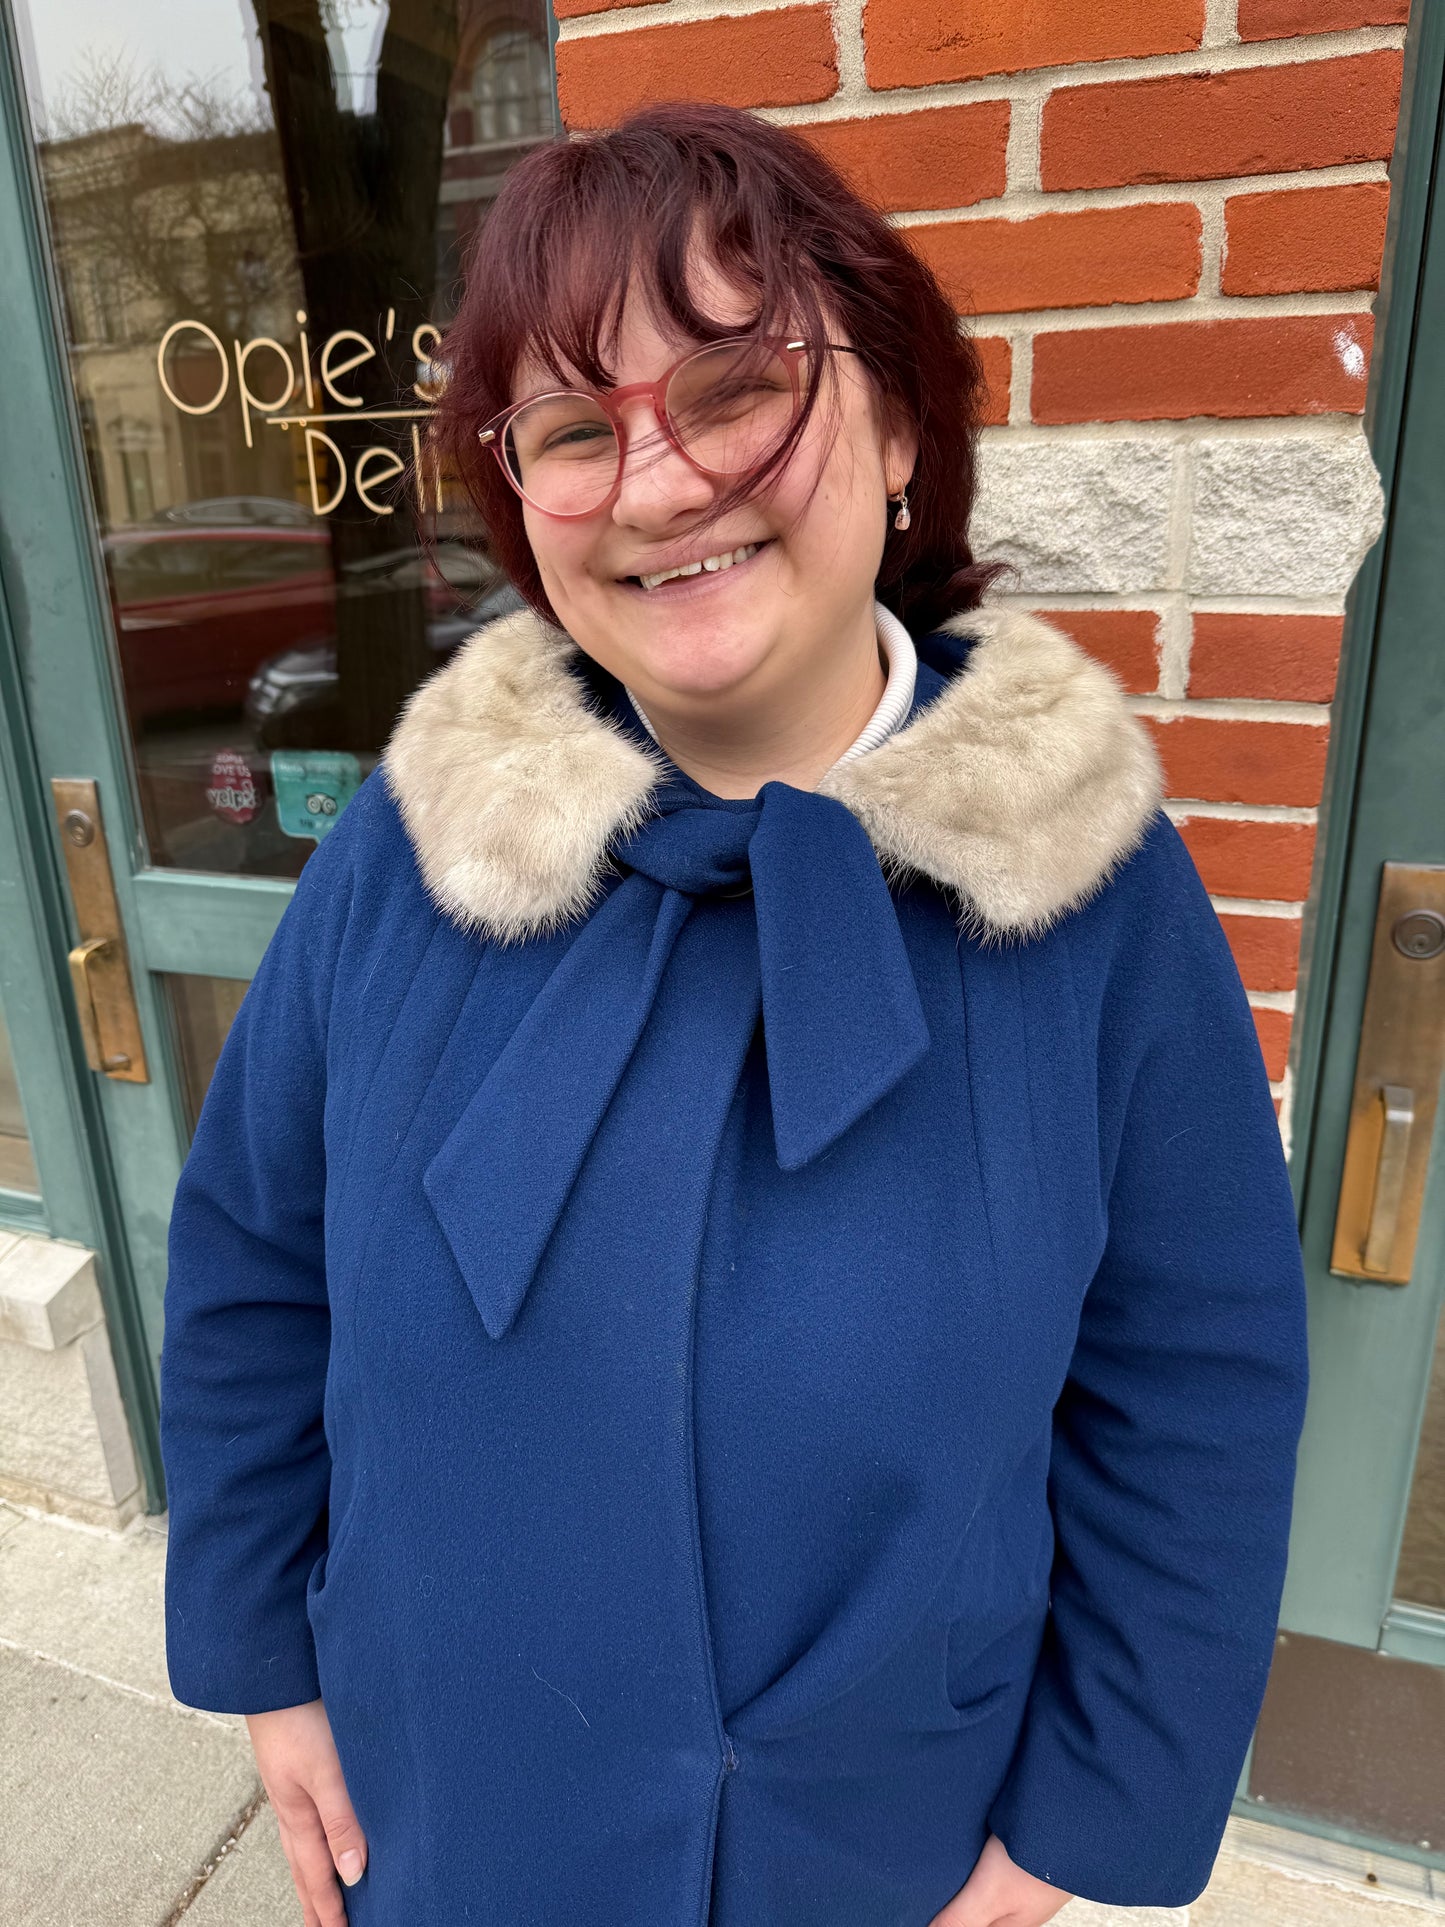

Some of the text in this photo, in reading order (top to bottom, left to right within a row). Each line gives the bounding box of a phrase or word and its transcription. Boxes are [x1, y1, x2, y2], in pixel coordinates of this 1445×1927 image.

[157, 307, 448, 448] Opie's
[305, 423, 443, 515] Deli
[206, 786, 245, 811] yelp
